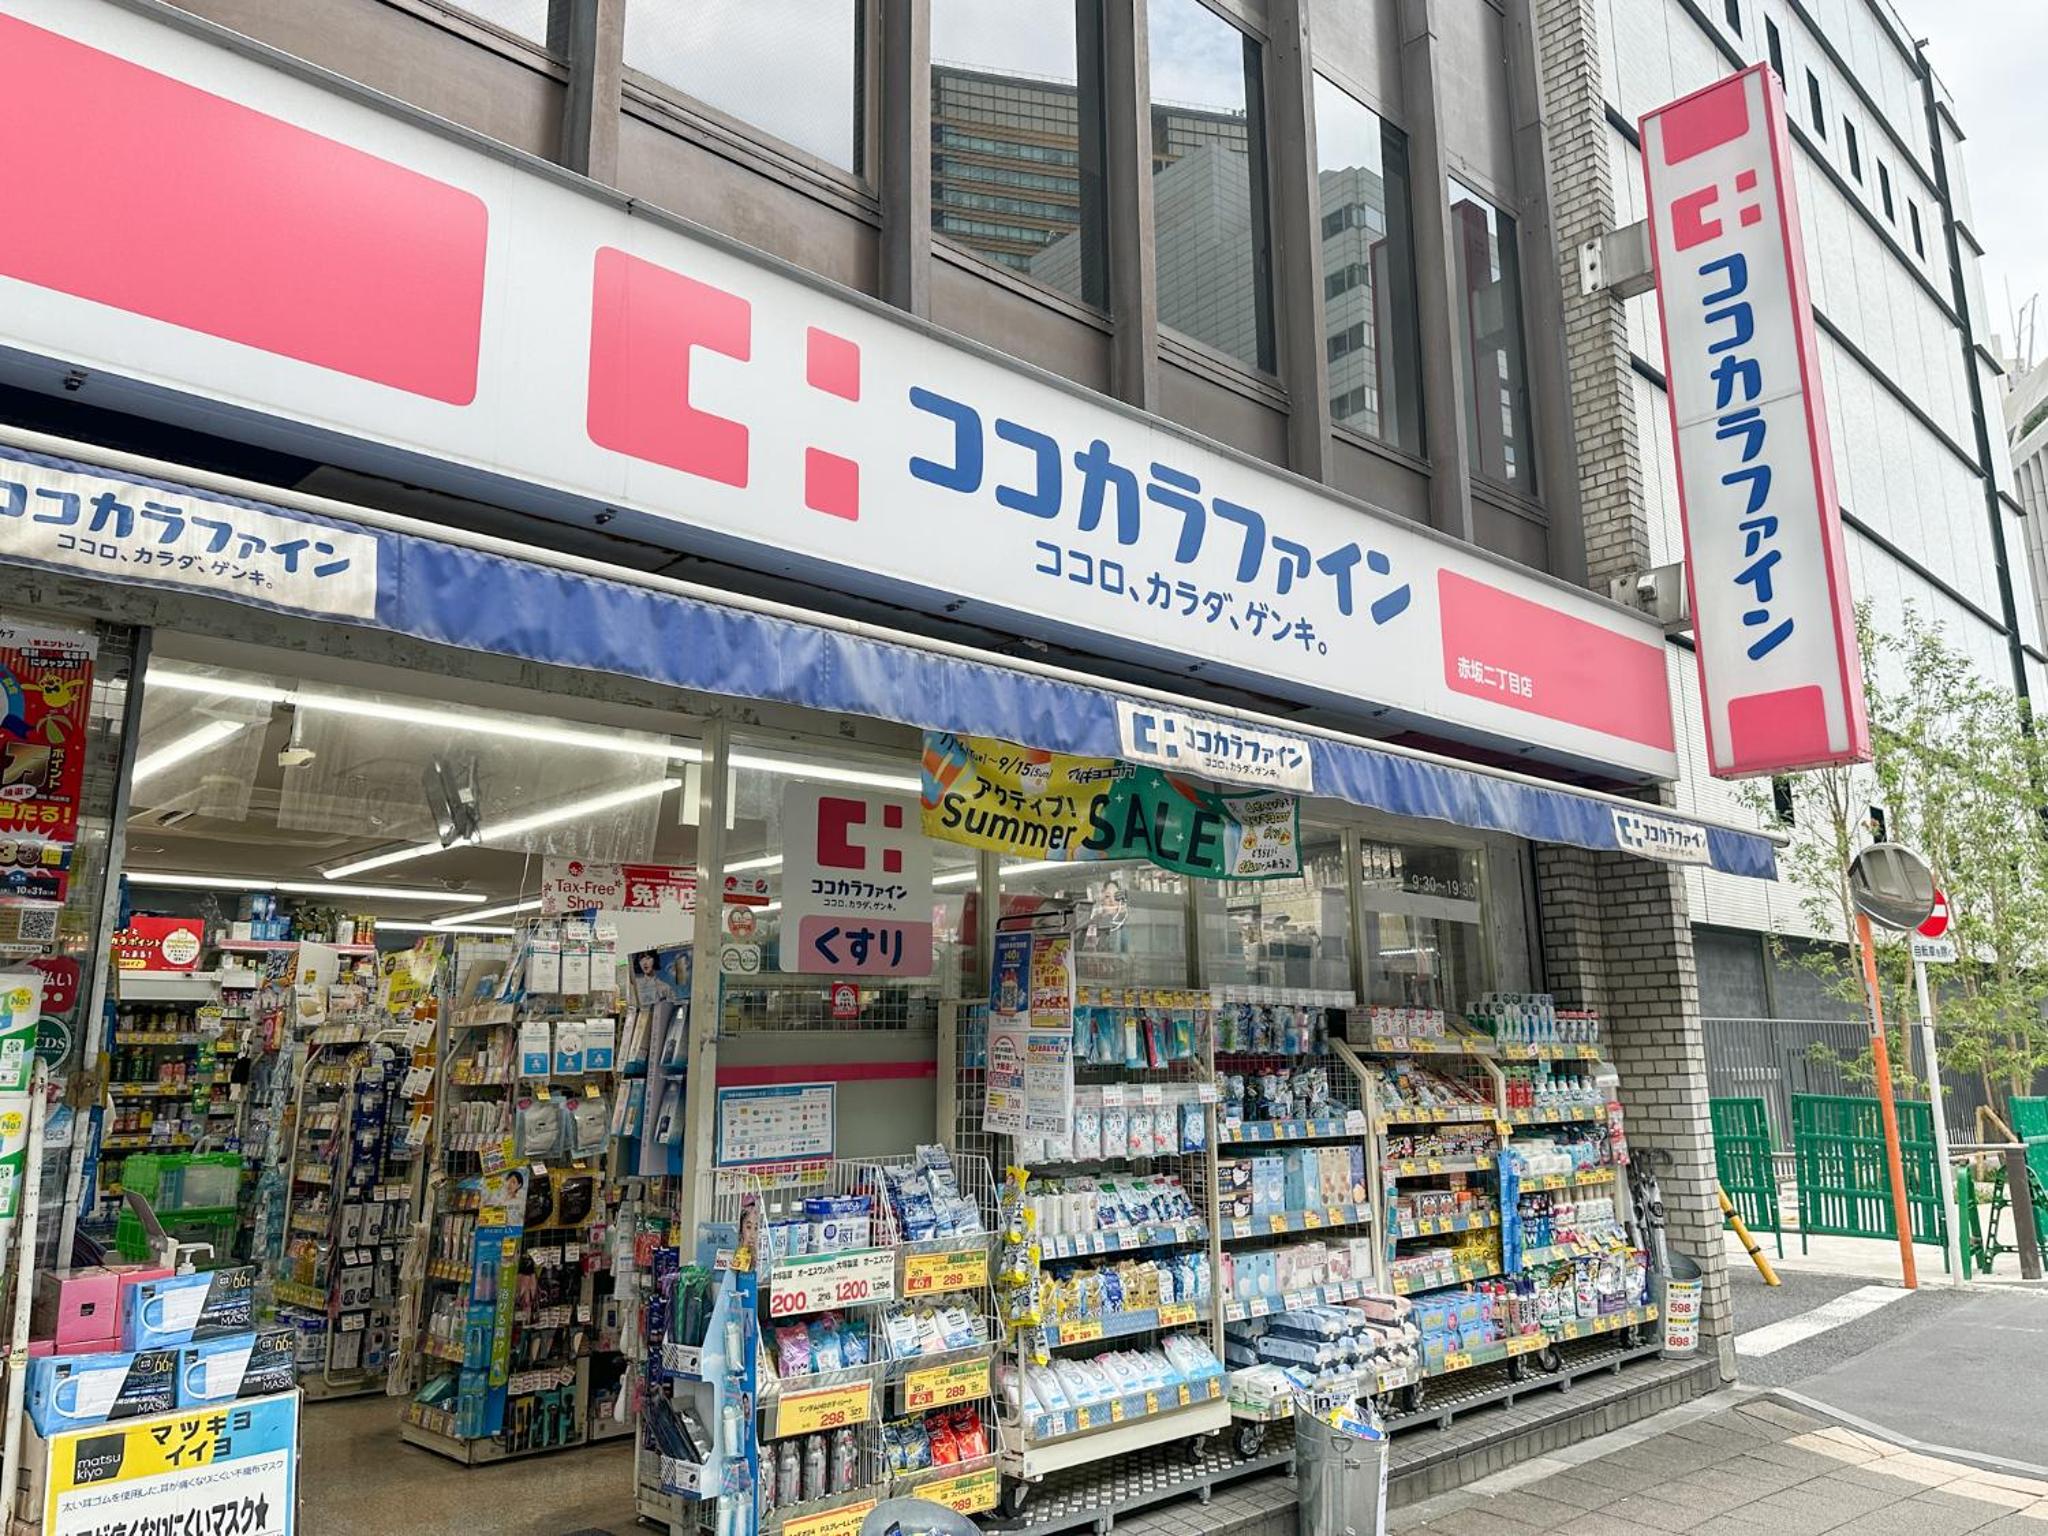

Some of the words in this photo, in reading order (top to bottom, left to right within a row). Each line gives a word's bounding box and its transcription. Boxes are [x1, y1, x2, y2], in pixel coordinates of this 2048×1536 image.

[1699, 252, 1793, 660] ココカラファイン
[908, 386, 1412, 624] ココカラファイン
[57, 534, 273, 589] ココロ、カラダ、ゲンキ。
[1036, 540, 1328, 656] ココロ、カラダ、ゲンキ。
[1457, 657, 1533, 698] 赤坂二丁目店
[1184, 726, 1303, 769] ココカラファイン
[49, 748, 65, 789] ポイント
[941, 792, 1077, 850] Summer
[1081, 795, 1222, 869] SALE
[555, 878, 616, 895] Tax-Free
[811, 879, 907, 900] ココカラファイン
[567, 895, 604, 910] Shop
[815, 927, 902, 967] くすり
[943, 1273, 963, 1286] 289
[771, 1291, 807, 1313] 200
[1670, 1303, 1691, 1313] 598
[220, 1314, 250, 1326] MASK
[263, 1377, 292, 1390] MASK
[946, 1384, 966, 1399] 289
[137, 1402, 168, 1414] MASK
[820, 1410, 845, 1427] 298
[150, 1410, 251, 1446] マツキヨ
[77, 1452, 121, 1466] matsu
[165, 1437, 232, 1466] イイヨ
[76, 1467, 104, 1483] kiyo
